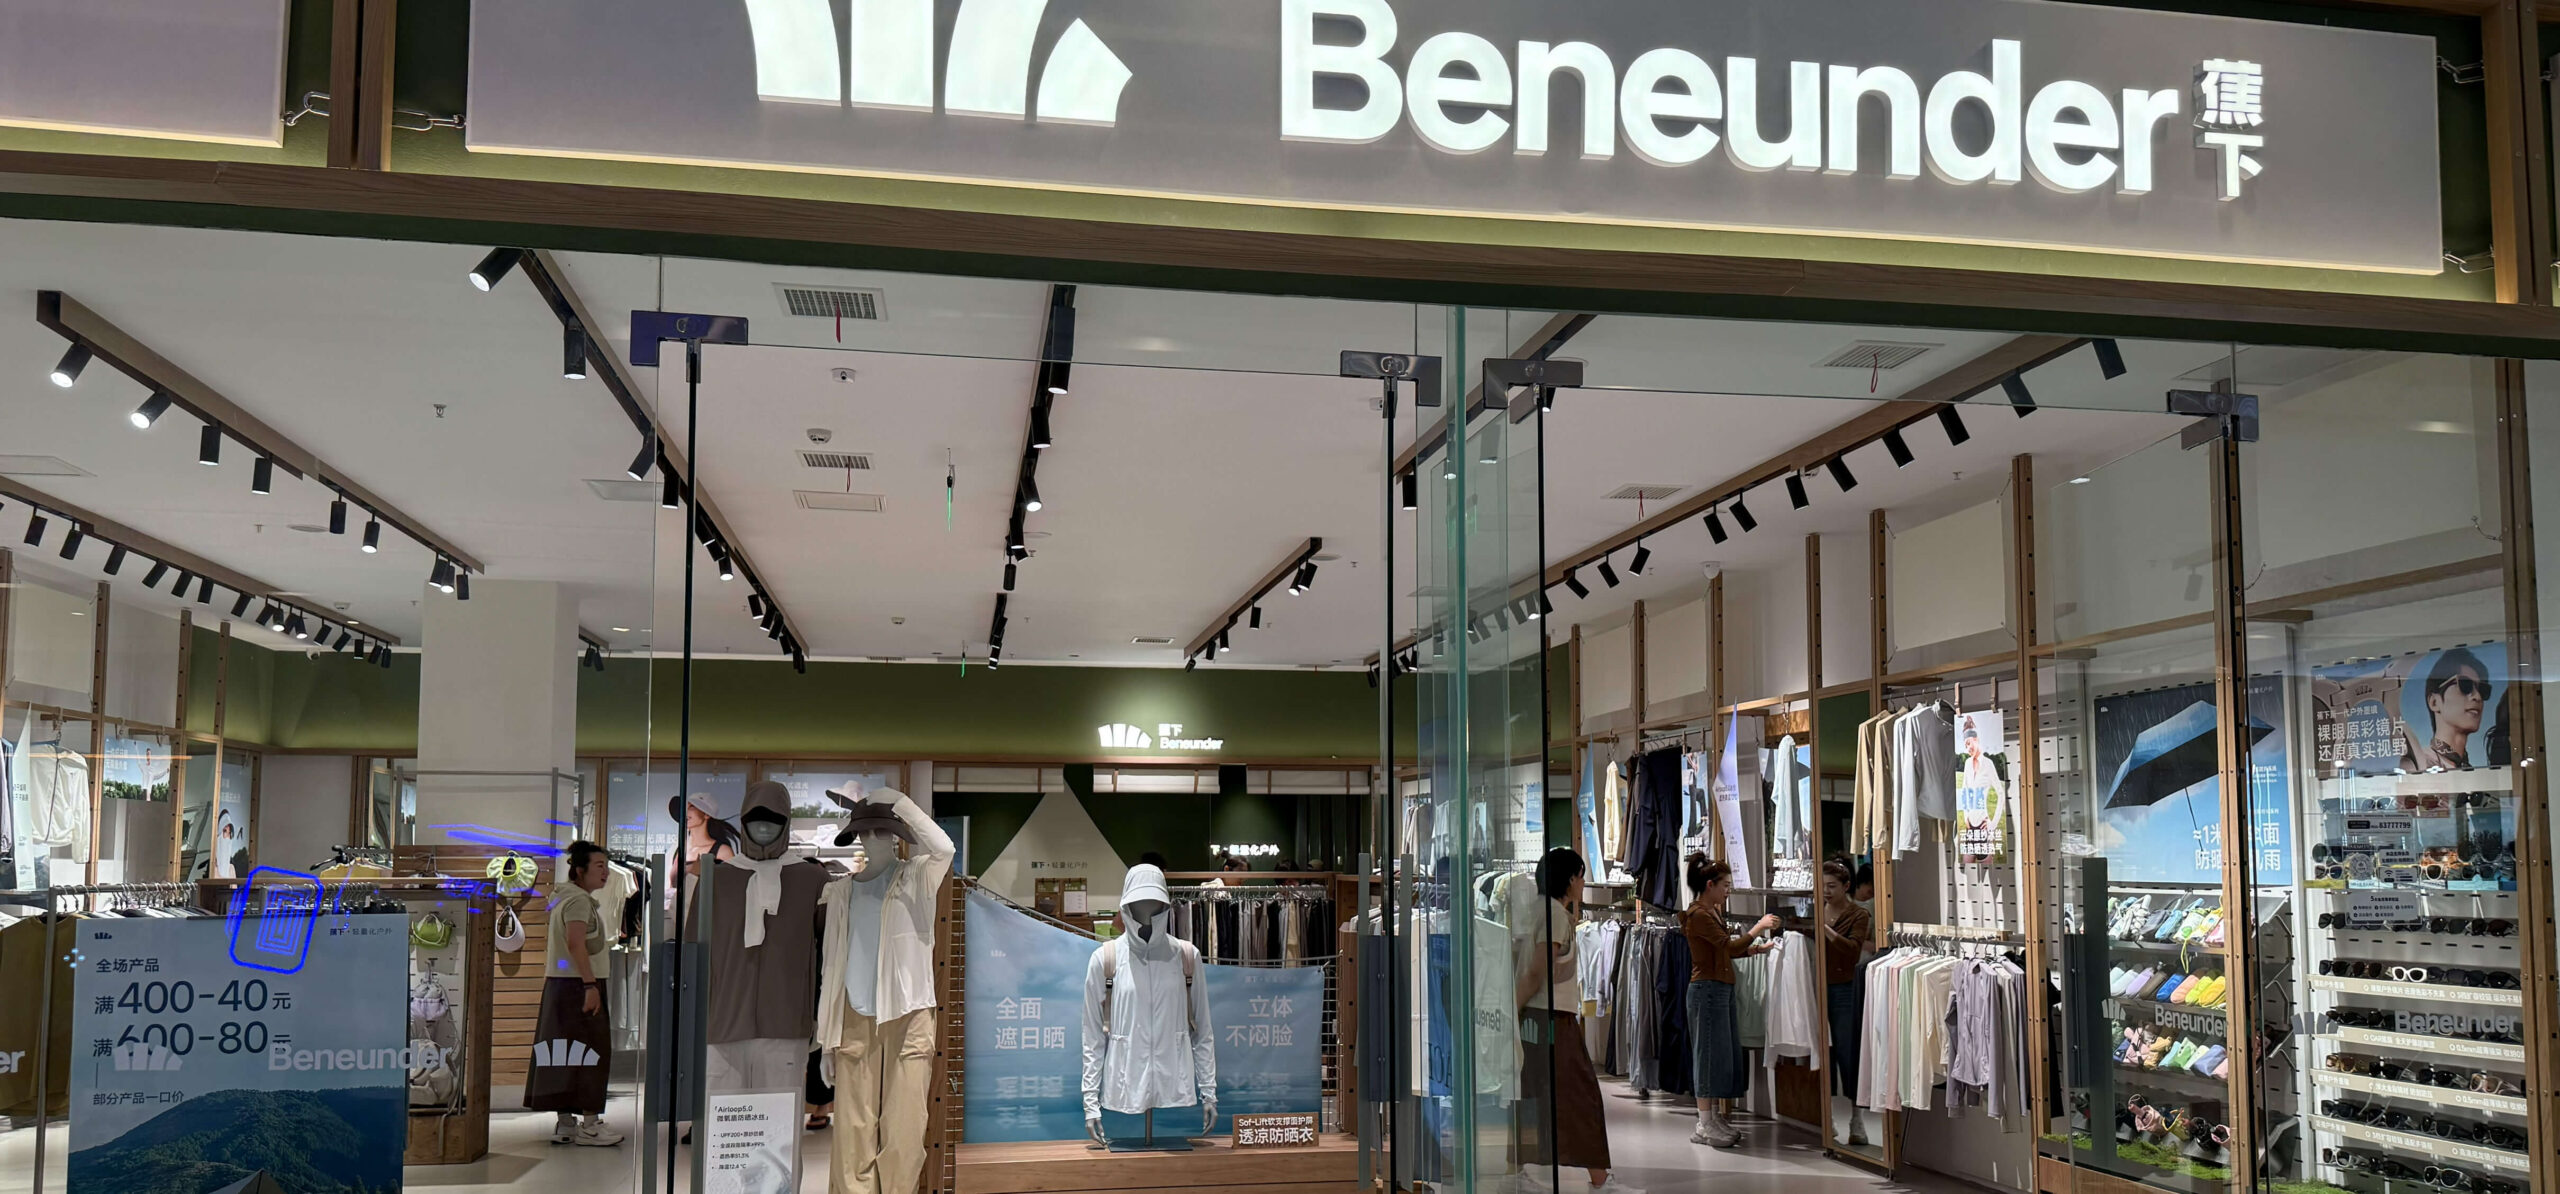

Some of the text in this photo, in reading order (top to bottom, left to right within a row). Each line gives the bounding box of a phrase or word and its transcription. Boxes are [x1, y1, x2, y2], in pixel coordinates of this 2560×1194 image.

[1280, 0, 2179, 191] Beneunder
[2200, 58, 2264, 197] 蕉下
[2317, 715, 2406, 742] 裸眼原彩镜片
[2317, 737, 2408, 762] 还原真实视野
[96, 958, 160, 974] 全场产品
[995, 996, 1043, 1020] 全面
[1248, 995, 1293, 1019] 立体
[2394, 1010, 2518, 1034] Beneunder
[995, 1026, 1066, 1050] 遮日晒
[1225, 1025, 1294, 1049] 不闷脸
[268, 1040, 453, 1071] Beneunder
[93, 1091, 185, 1106] 部分产品一口价
[1238, 1126, 1314, 1145] 透凉防晒衣
